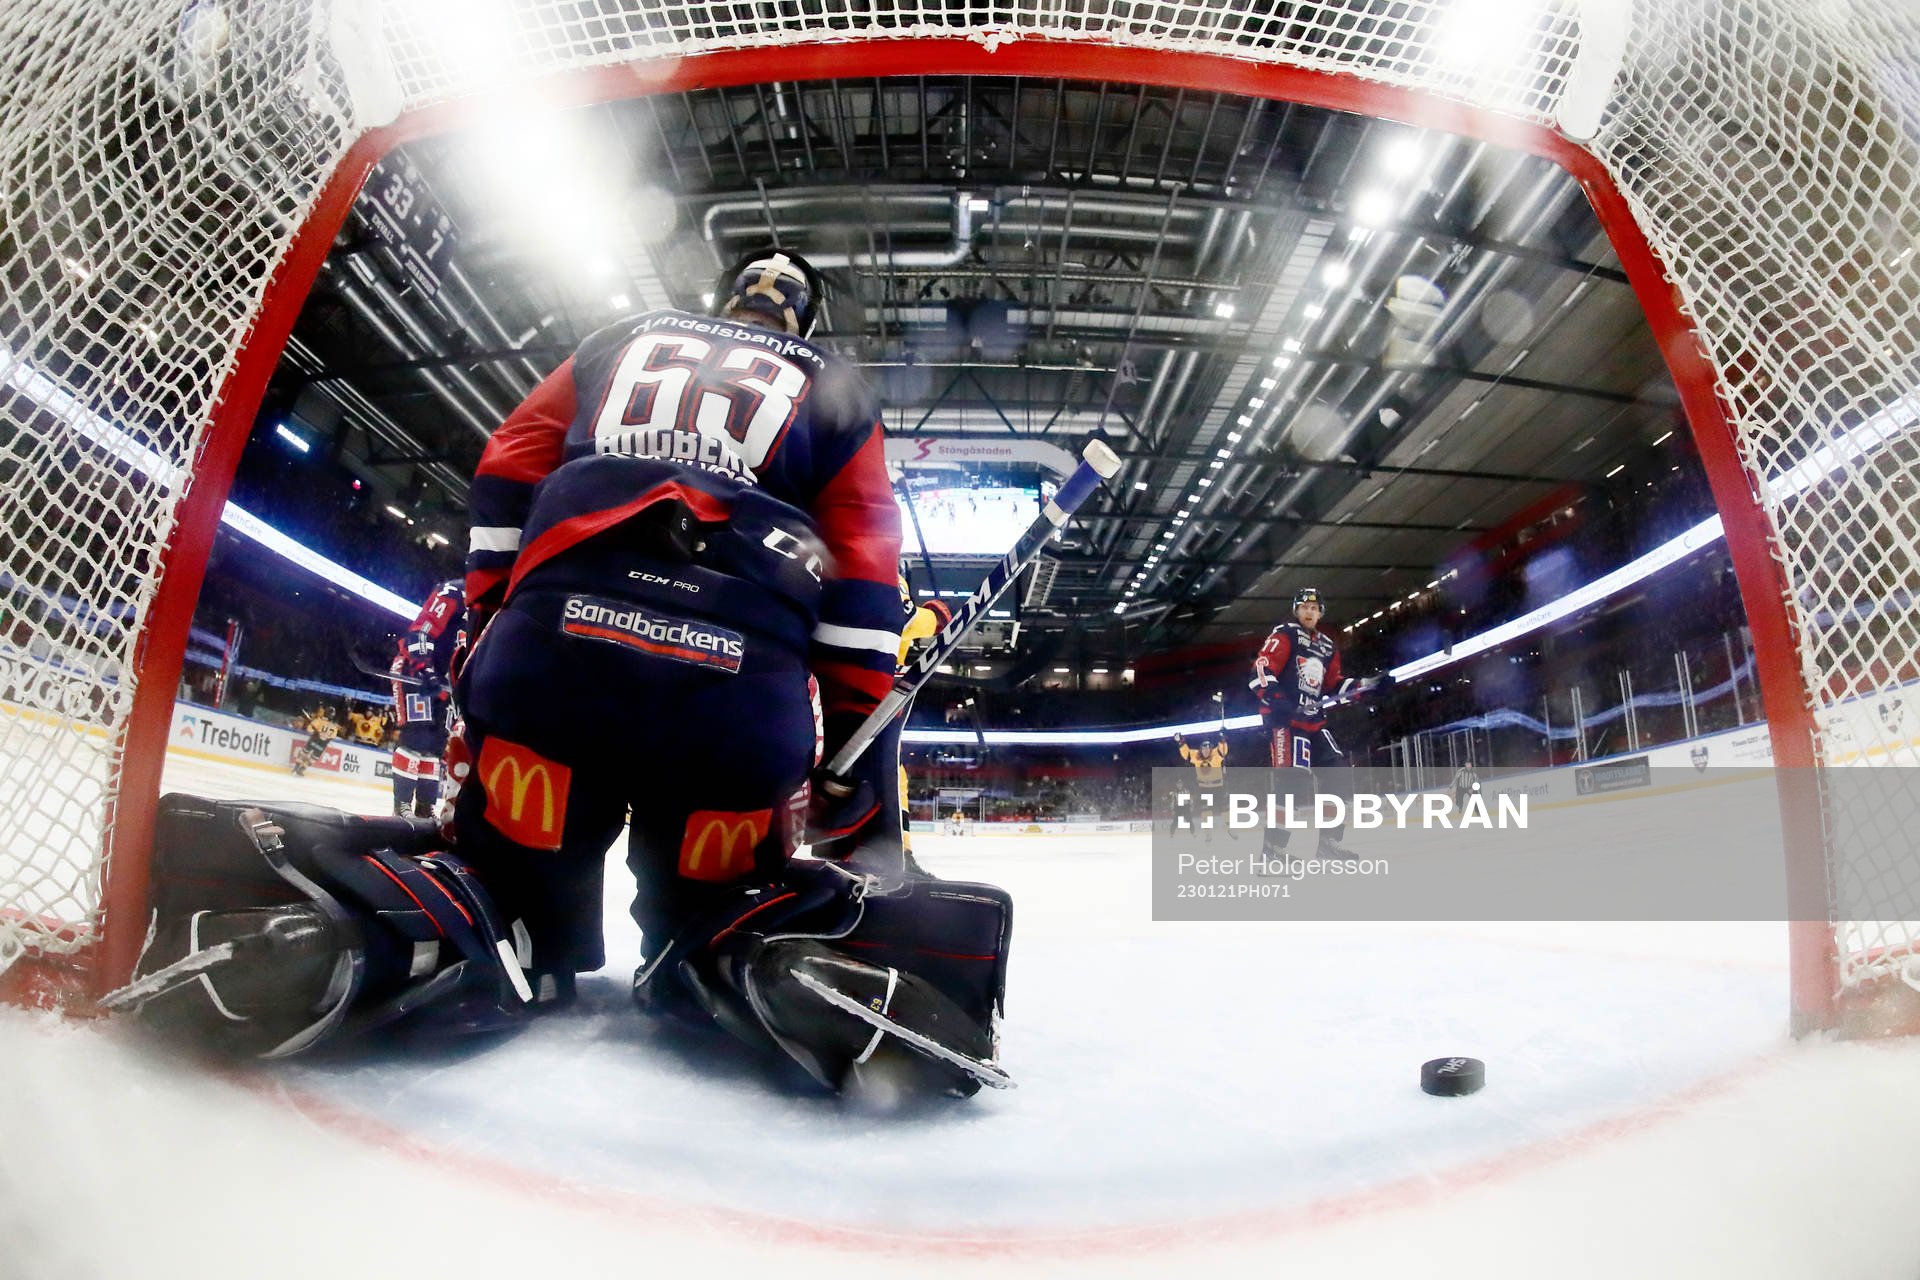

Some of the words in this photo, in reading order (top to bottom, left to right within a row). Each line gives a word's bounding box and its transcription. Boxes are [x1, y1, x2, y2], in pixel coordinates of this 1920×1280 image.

[384, 173, 414, 220] 33
[426, 229, 444, 260] 7
[593, 333, 808, 470] 63
[628, 570, 671, 585] CCM
[673, 580, 700, 594] PRO
[429, 597, 447, 619] 14
[918, 578, 991, 674] CCM
[564, 598, 744, 657] Sandbäckens
[199, 719, 271, 757] Trebolit
[344, 752, 359, 764] ALL
